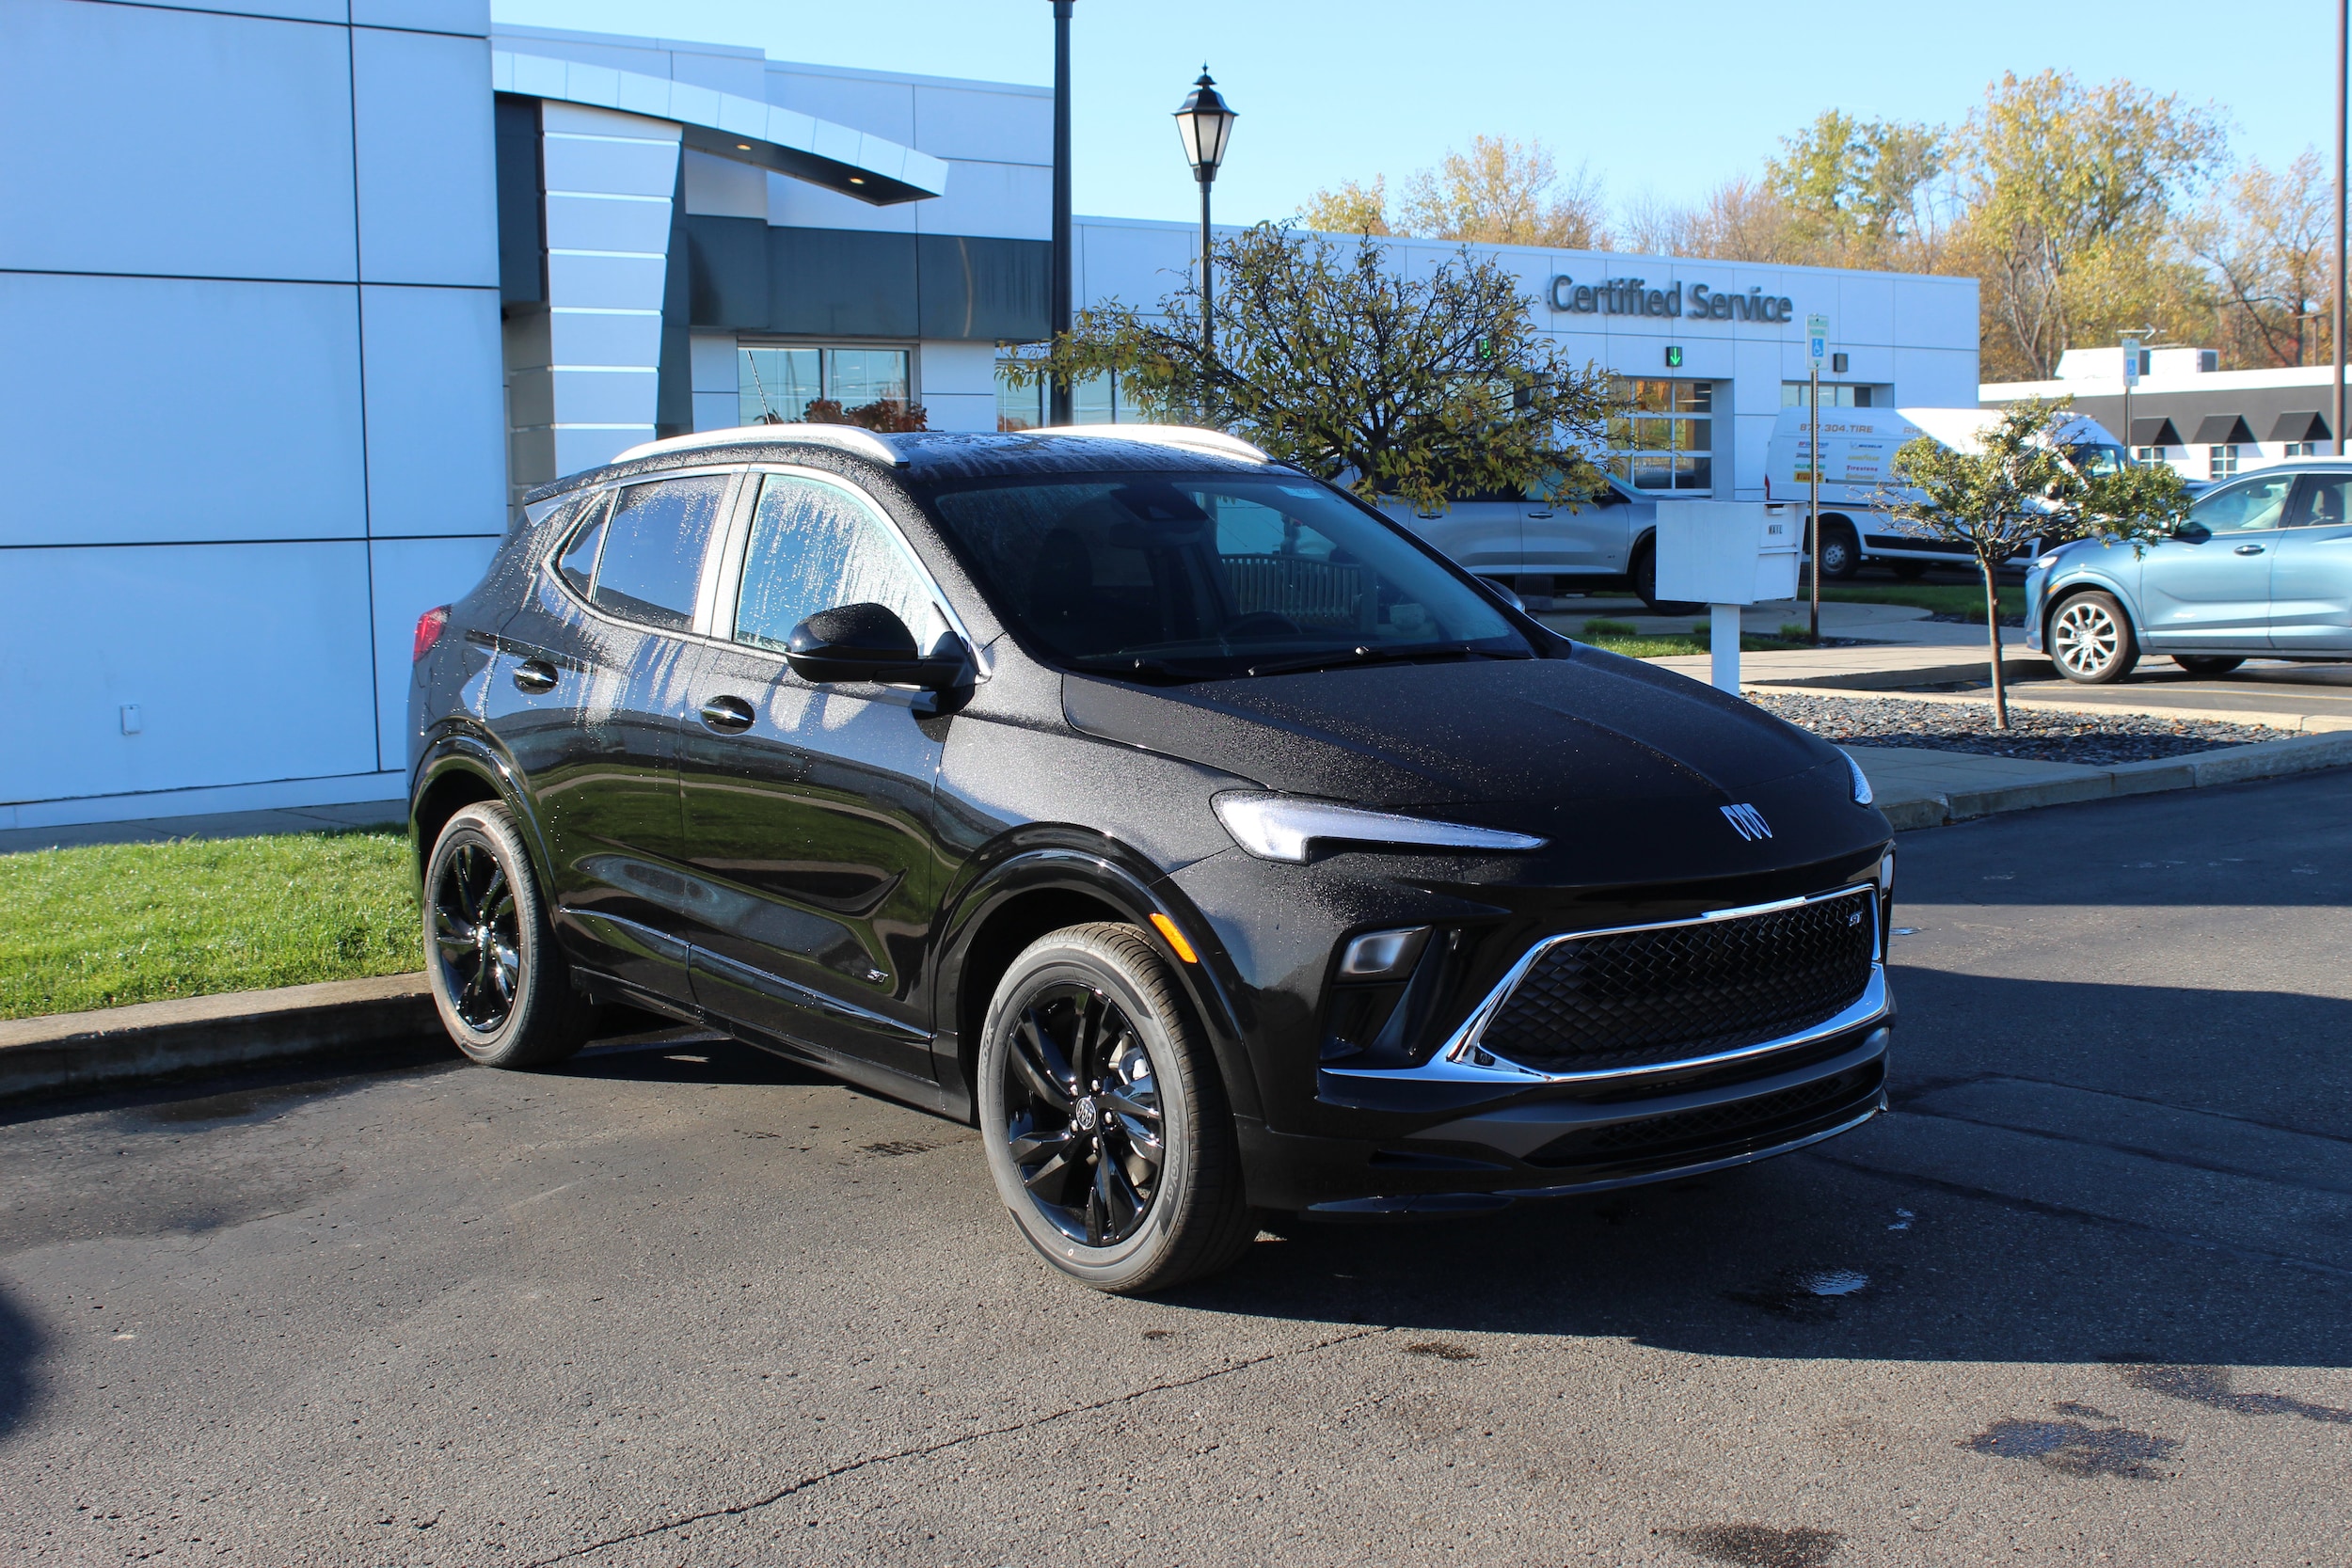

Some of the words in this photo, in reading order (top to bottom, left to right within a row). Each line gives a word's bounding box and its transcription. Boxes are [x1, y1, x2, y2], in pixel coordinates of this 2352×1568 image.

[1548, 275, 1682, 317] Certified
[1687, 283, 1793, 324] Service
[1769, 525, 1783, 534] MAIL
[1849, 911, 1863, 927] ST
[866, 968, 889, 983] ST
[980, 1022, 994, 1109] NKOOK
[1170, 1111, 1181, 1187] KINERGY
